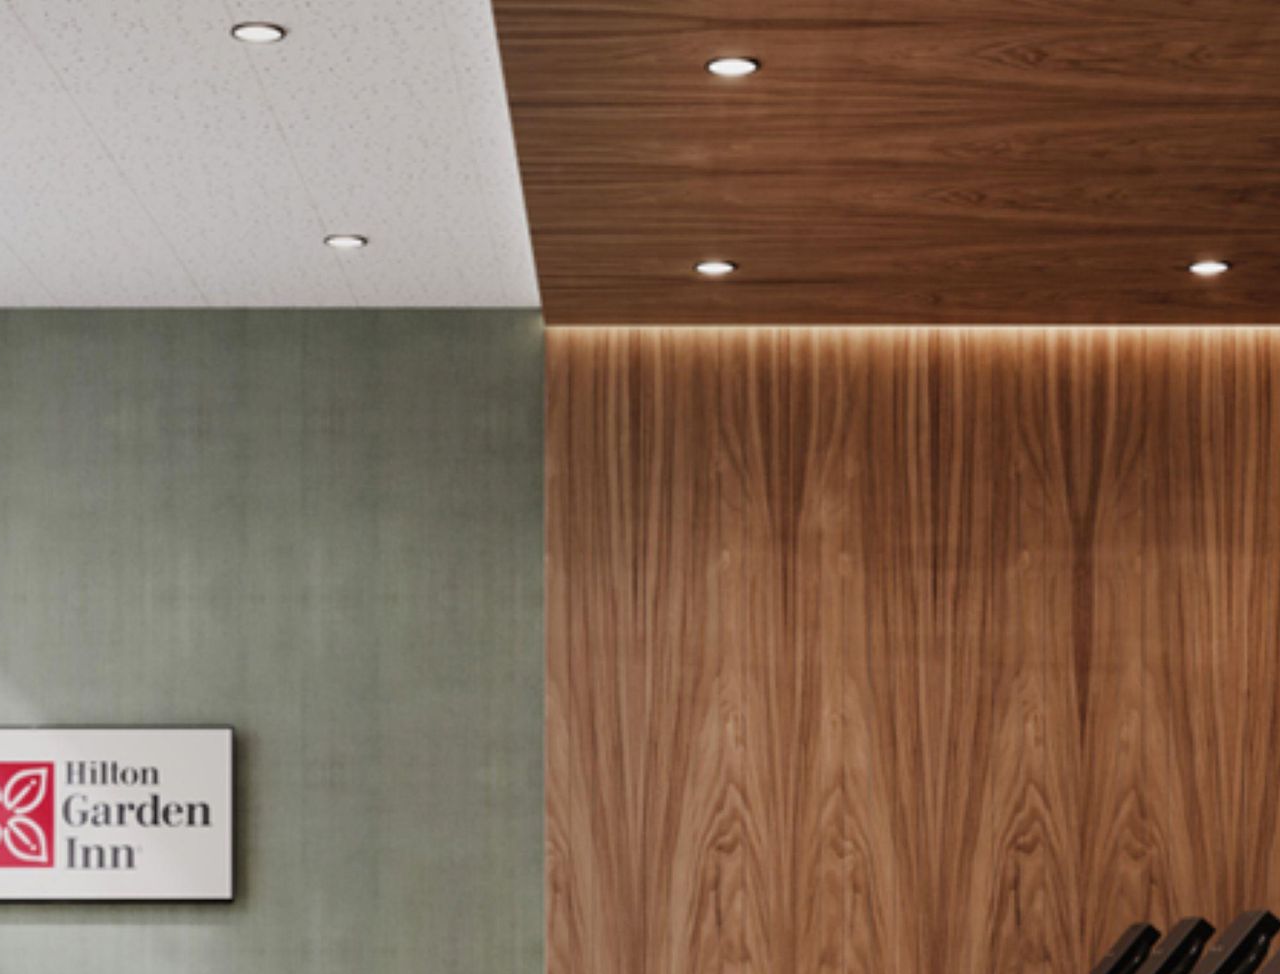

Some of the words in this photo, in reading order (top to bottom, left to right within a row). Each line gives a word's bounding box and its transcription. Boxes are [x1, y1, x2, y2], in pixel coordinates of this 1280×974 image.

[65, 760, 160, 786] Hilton
[61, 793, 213, 828] Garden
[65, 837, 136, 870] Inn
